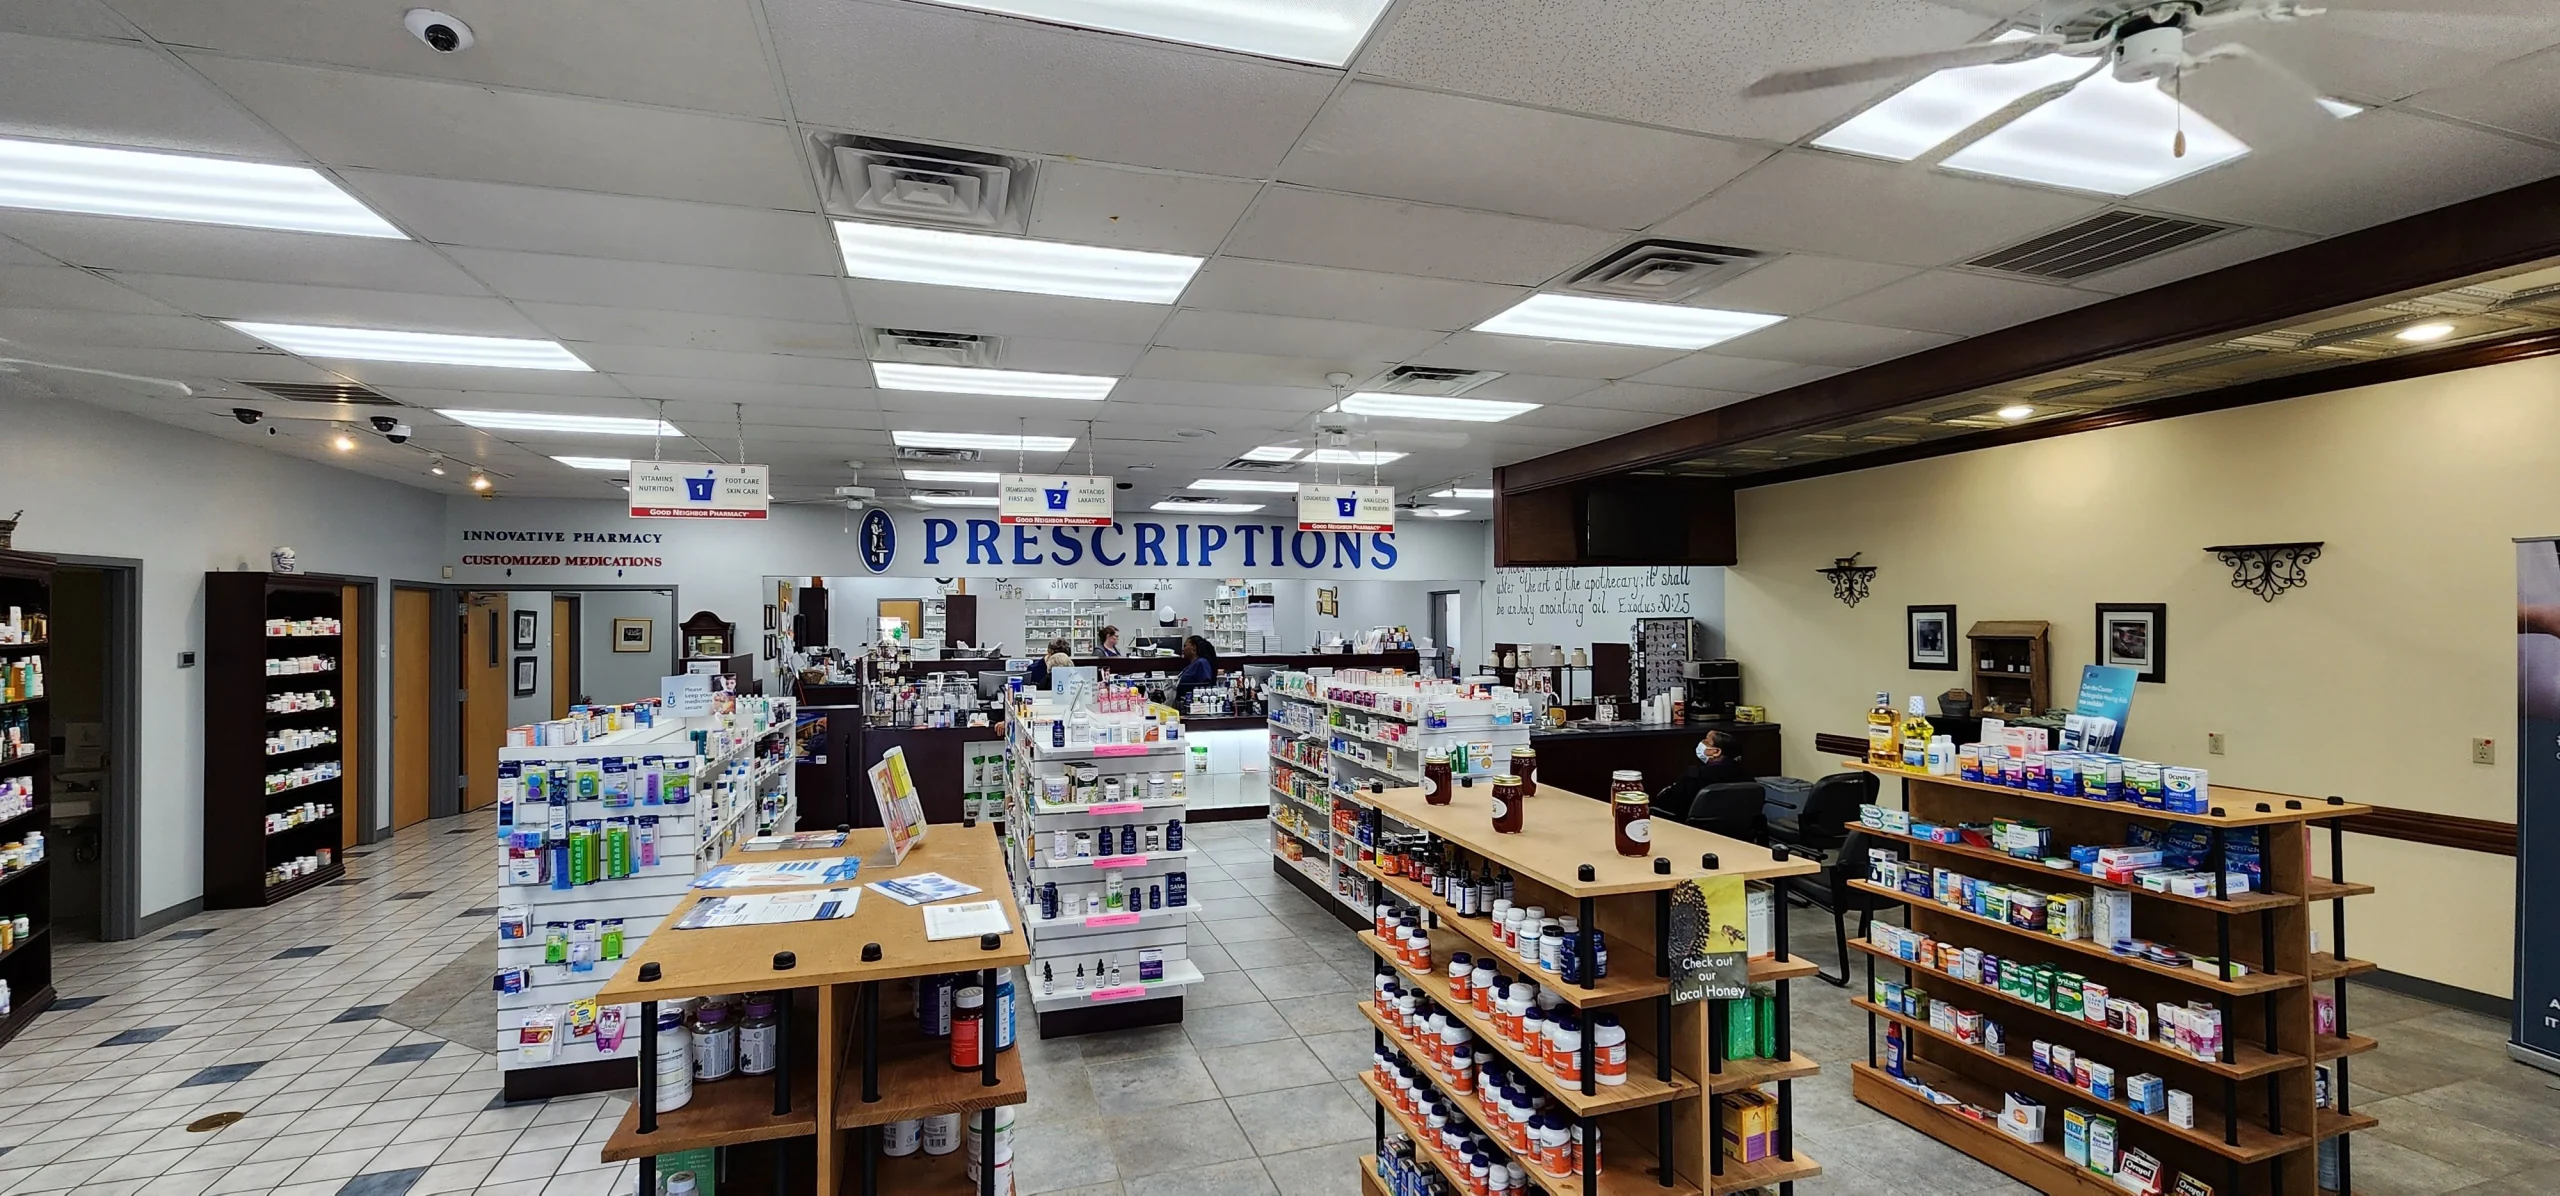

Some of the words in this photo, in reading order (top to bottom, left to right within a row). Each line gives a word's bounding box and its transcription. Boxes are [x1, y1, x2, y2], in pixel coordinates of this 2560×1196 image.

[696, 484, 703, 496] 1
[1053, 494, 1062, 504] 2
[1344, 502, 1351, 512] 3
[462, 530, 565, 542] INNOVATIVE
[574, 532, 663, 544] PHARMACY
[922, 518, 1398, 570] PRESCRIPTIONS
[462, 555, 560, 566] CUSTOMIZED
[565, 556, 663, 567] MEDICATIONS
[1051, 580, 1078, 590] silver
[1094, 580, 1133, 594] potassium
[1154, 580, 1173, 590] zinc
[1496, 576, 1516, 594] after
[1524, 573, 1536, 593] the
[1537, 572, 1550, 592] art
[1661, 566, 1690, 586] shall
[1496, 596, 1504, 616] be
[1517, 594, 1535, 626] holy
[1540, 592, 1584, 628] anointing
[1618, 595, 1656, 614] Exodus
[1658, 592, 1690, 614] 30:25
[2168, 773, 2192, 781] Ocuvite
[1682, 955, 1714, 970] Check
[1716, 956, 1733, 966] out
[1698, 972, 1716, 981] our
[2056, 976, 2081, 990] Systane
[1675, 984, 1702, 1002] Local
[1706, 984, 1746, 1000] Honey
[2126, 1159, 2152, 1178] Orajel
